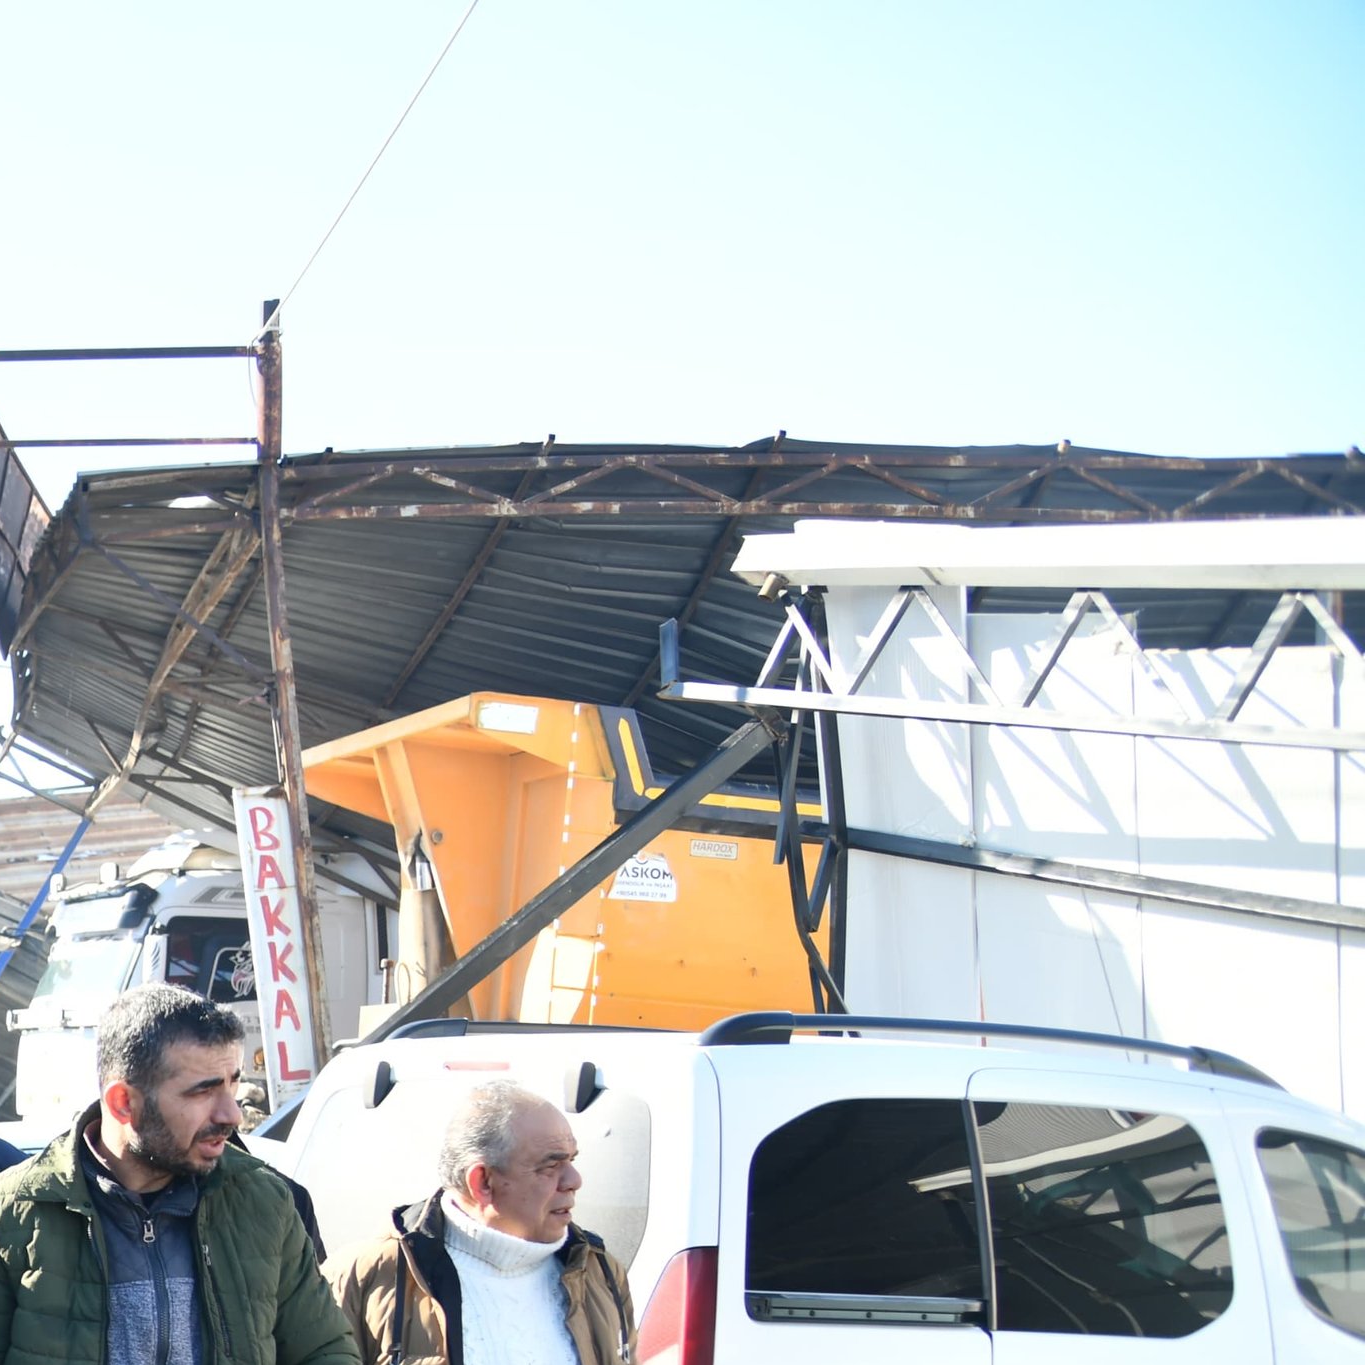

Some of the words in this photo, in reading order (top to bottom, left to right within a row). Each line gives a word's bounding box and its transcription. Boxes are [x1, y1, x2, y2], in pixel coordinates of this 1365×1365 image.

[693, 841, 734, 854] HARDOX
[619, 866, 673, 880] ASKOM
[250, 806, 311, 1082] BAKKAL
